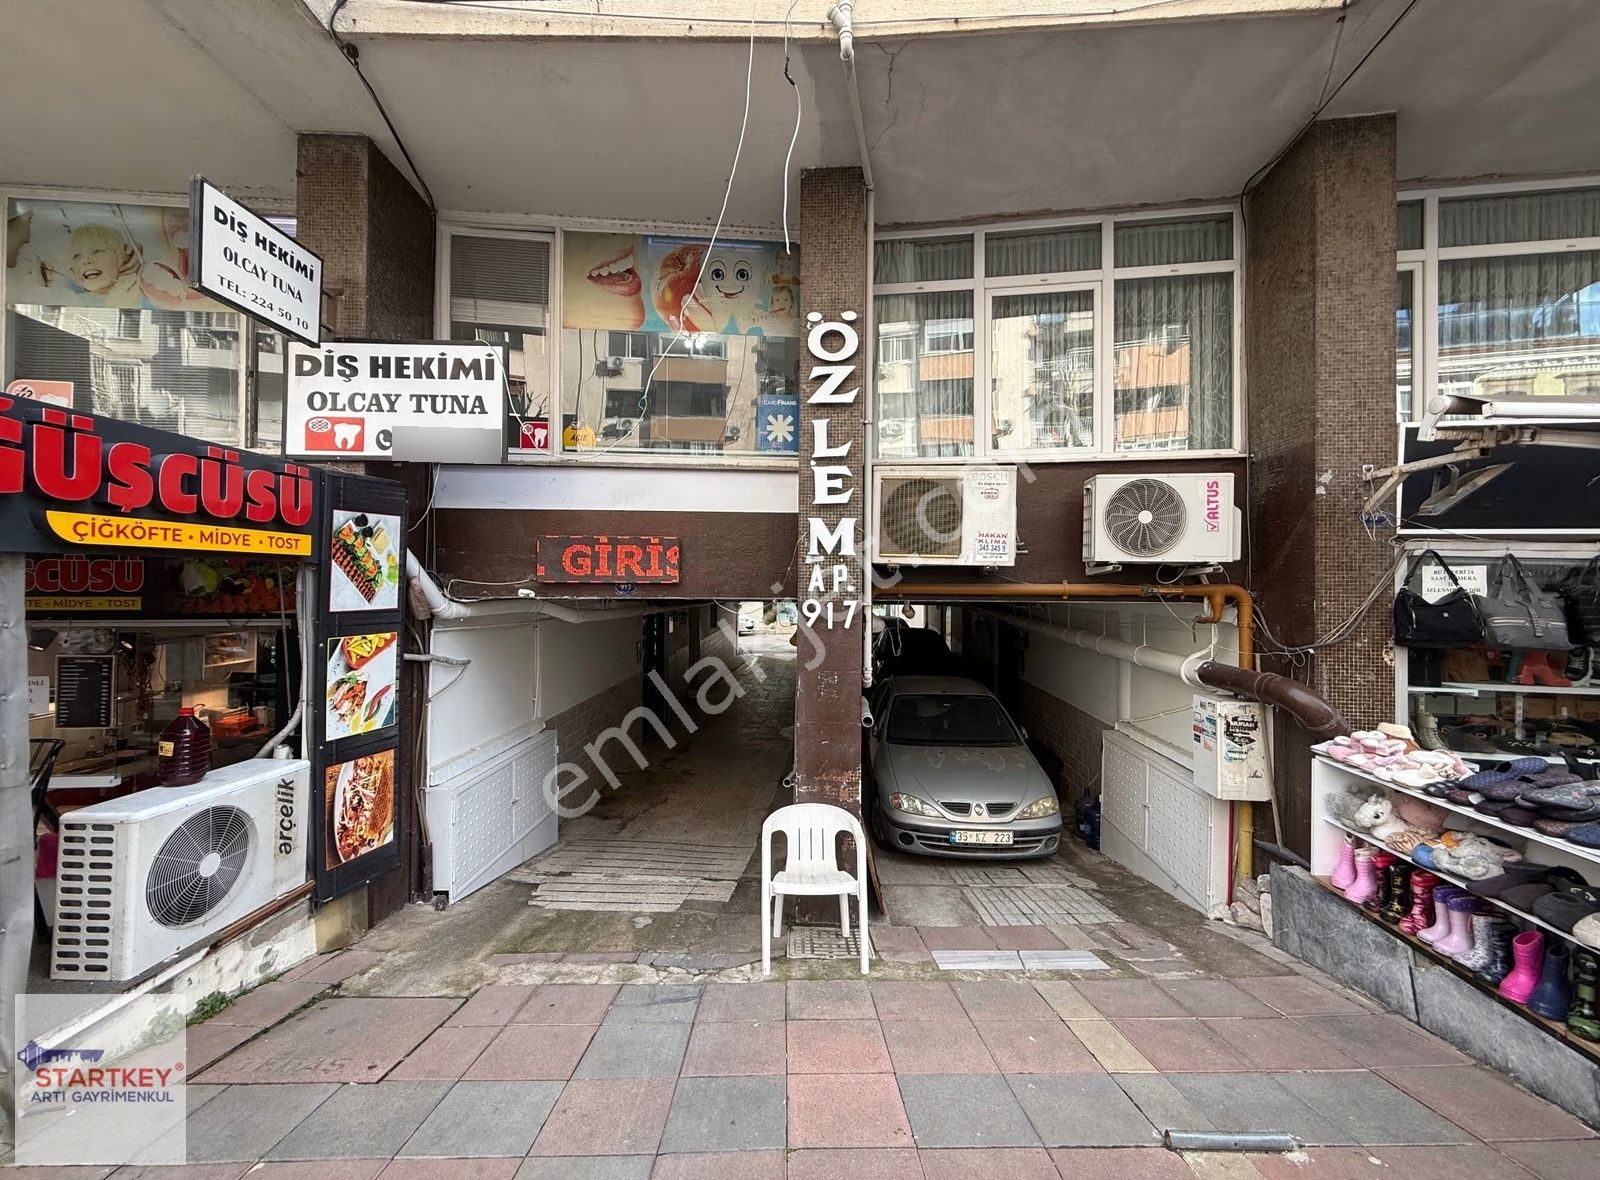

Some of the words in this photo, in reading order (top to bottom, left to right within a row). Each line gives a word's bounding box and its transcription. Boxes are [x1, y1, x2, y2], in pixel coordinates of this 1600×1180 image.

[214, 205, 248, 243] DİŞ
[255, 231, 315, 283] HEKİMİ
[223, 246, 268, 282] OLCAY
[271, 273, 304, 303] TUNA
[217, 274, 247, 298] TEL:
[251, 293, 274, 312] 224
[278, 308, 292, 322] 50
[295, 317, 309, 330] 10
[294, 349, 359, 383] DİŞ
[369, 351, 496, 381] HEKİMİ
[306, 390, 402, 413] OLCAY
[409, 393, 488, 415] TUNA
[806, 310, 862, 556] ÖZLEM
[1206, 480, 1219, 520] ALTUS
[72, 517, 183, 542] ÇİĞKÖFTE
[199, 528, 251, 546] MİDYE
[267, 536, 301, 550] TOST
[105, 599, 137, 608] TOST
[801, 599, 858, 630] 917
[277, 777, 297, 855] arçelik
[957, 831, 968, 842] 35
[994, 833, 1011, 843] 223
